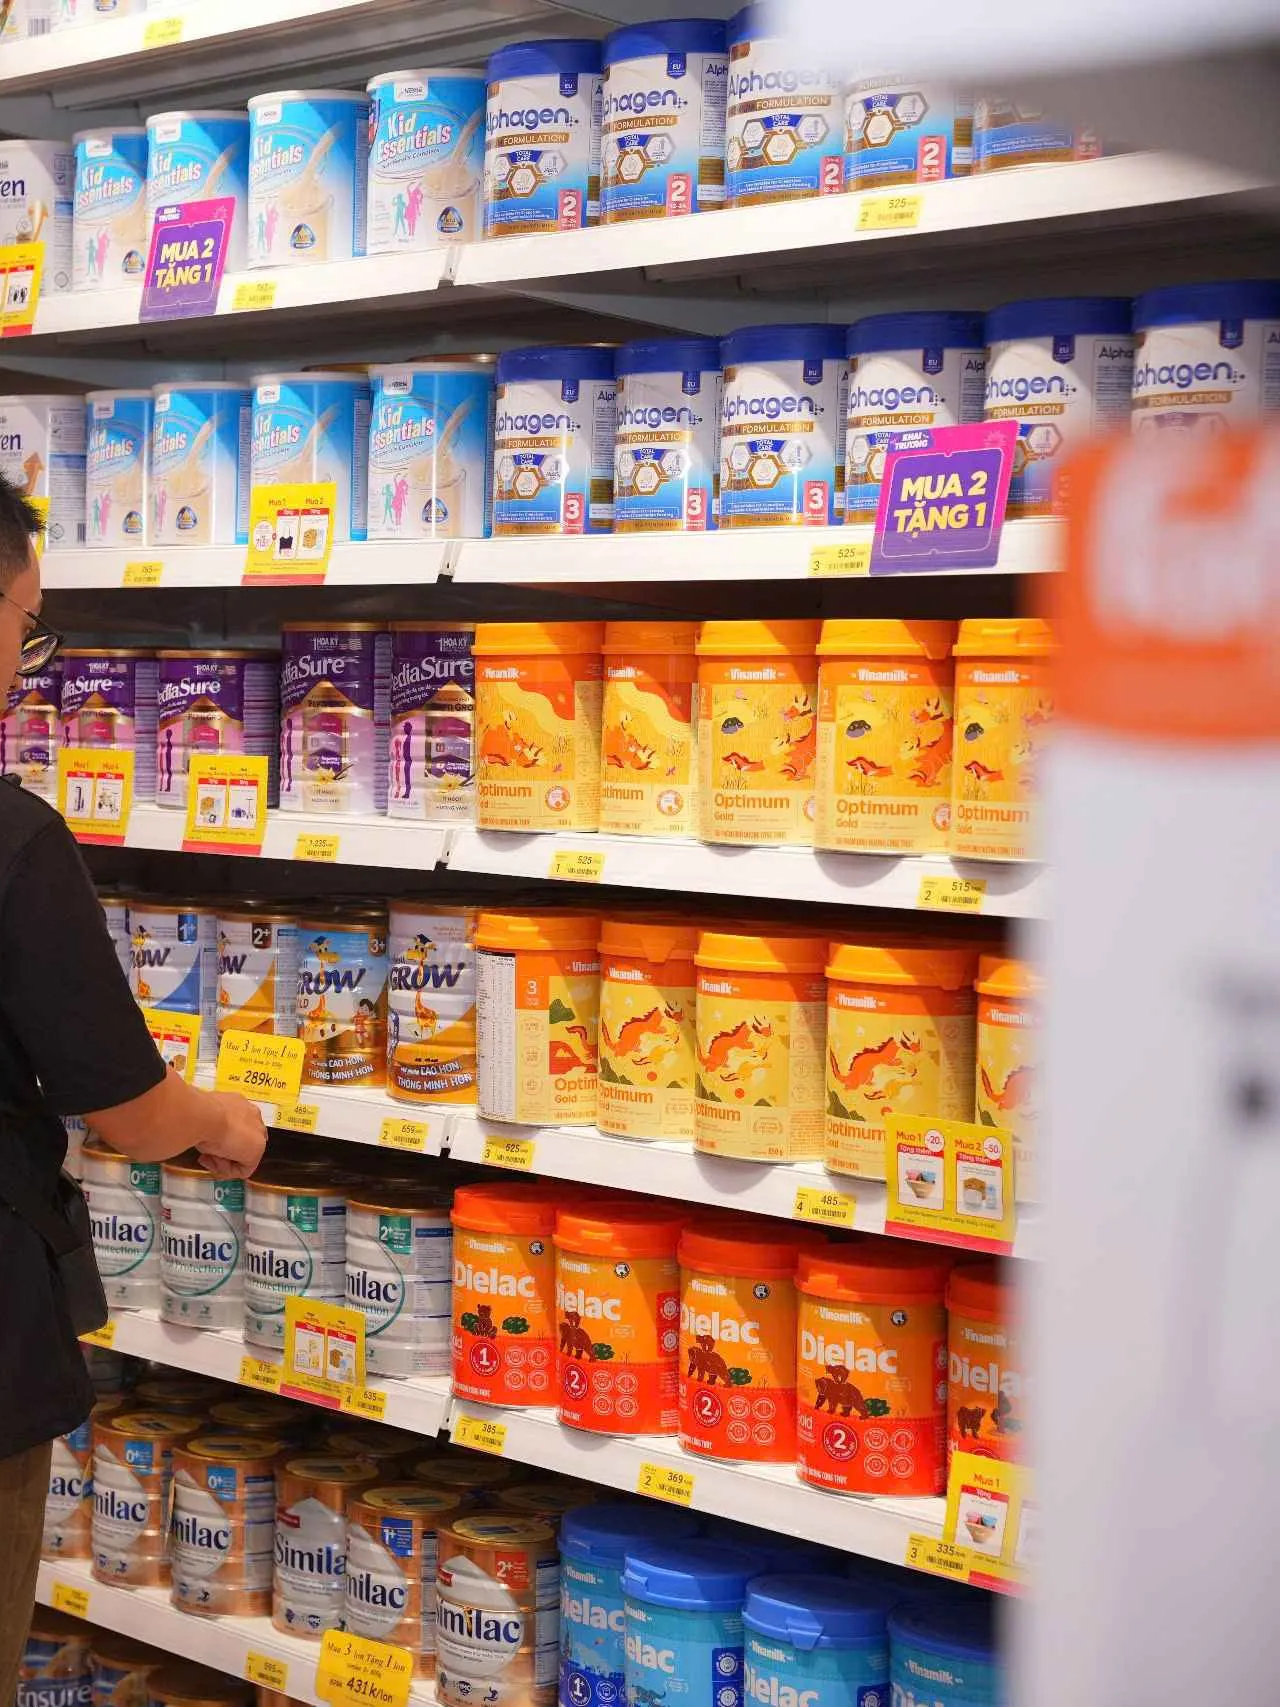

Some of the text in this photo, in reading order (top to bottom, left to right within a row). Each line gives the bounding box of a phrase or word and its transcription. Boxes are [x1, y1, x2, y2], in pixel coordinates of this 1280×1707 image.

[602, 89, 680, 120] phagen
[756, 95, 829, 110] FORMULATION
[387, 111, 417, 141] Kid
[612, 116, 675, 131] FORMULATION
[503, 134, 566, 146] FORMULATION
[922, 142, 941, 166] 2
[823, 163, 840, 185] 2
[671, 181, 687, 202] 2
[563, 196, 577, 217] 2
[888, 198, 907, 209] 525
[160, 238, 215, 265] MUA 2
[155, 260, 213, 292] TẶNG 1
[850, 386, 934, 411] phagen
[1147, 391, 1230, 408] FORMULATION
[617, 405, 692, 429] phagen
[862, 414, 930, 425] FORMULATION
[993, 404, 1061, 419] FORMULATION
[741, 423, 812, 434] FORMULATION
[900, 470, 988, 503] MUA 2
[687, 493, 701, 515] 3
[807, 487, 824, 510] 3
[566, 499, 579, 520] 3
[893, 499, 987, 538] TẶNG 1
[837, 548, 856, 558] 525
[280, 655, 345, 687] diaSure
[730, 668, 777, 680] Vinamilk
[857, 669, 909, 682] Vinamilk
[973, 670, 1021, 682] Vinamilk
[62, 675, 113, 699] diaSure
[714, 793, 790, 810] Optimum
[836, 799, 919, 819] Optimum
[713, 812, 734, 822] Gold
[836, 819, 858, 829] Gold
[957, 806, 1030, 824] Optimum
[577, 855, 593, 865] 525
[924, 889, 932, 901] 2
[951, 880, 970, 892] 515
[178, 921, 197, 942] 1+
[253, 926, 272, 946] 2+
[296, 967, 367, 996] ROW
[389, 962, 466, 991] GROW
[527, 980, 537, 995] 3
[838, 993, 877, 1009] Vinamilk
[242, 1039, 250, 1052] 3
[280, 1044, 287, 1057] 1
[328, 1058, 344, 1068] CAO
[420, 1066, 437, 1076] CAO
[331, 1070, 354, 1080] MINH
[423, 1078, 448, 1090] MINH
[554, 1078, 598, 1096] Optim
[554, 1094, 577, 1104] Gold
[383, 1130, 389, 1140] 2
[896, 1130, 915, 1141] Mua
[954, 1139, 982, 1152] Mua 2
[131, 1169, 148, 1185] 0+
[214, 1187, 231, 1202] 0+
[820, 1194, 838, 1206] 485
[287, 1205, 302, 1222] 1+
[796, 1201, 804, 1212] 4
[380, 1224, 394, 1241] 2+
[162, 1232, 233, 1263] imilac
[246, 1249, 306, 1281] milac
[346, 1270, 399, 1303] milac
[453, 1260, 536, 1298] Dielac
[691, 1278, 728, 1297] Vinamilk
[557, 1284, 622, 1321] ielac
[680, 1303, 760, 1345] Dielac
[819, 1307, 865, 1325] Vinamilk
[964, 1327, 1008, 1348] Vinamilk
[478, 1347, 489, 1366] 1
[801, 1330, 897, 1374] Dielac
[570, 1371, 581, 1390] 2
[949, 1351, 1027, 1398] Diela
[701, 1396, 712, 1416] 2
[481, 1423, 497, 1434] 385
[832, 1429, 847, 1450] 2
[644, 1474, 652, 1487] 2
[667, 1471, 684, 1484] 369
[973, 1472, 994, 1487] Mua
[93, 1490, 146, 1523] milac
[171, 1516, 231, 1551] milac
[274, 1531, 348, 1576] Simila
[910, 1545, 918, 1559] 3
[936, 1543, 954, 1555] 335
[496, 1560, 514, 1578] 2+
[346, 1573, 405, 1610] milac
[436, 1596, 521, 1644] imilac
[343, 1642, 352, 1656] 3
[386, 1655, 393, 1668] 1
[624, 1634, 674, 1674] elac
[751, 1640, 786, 1663] Vinamilk
[908, 1658, 953, 1686] Vinamilk
